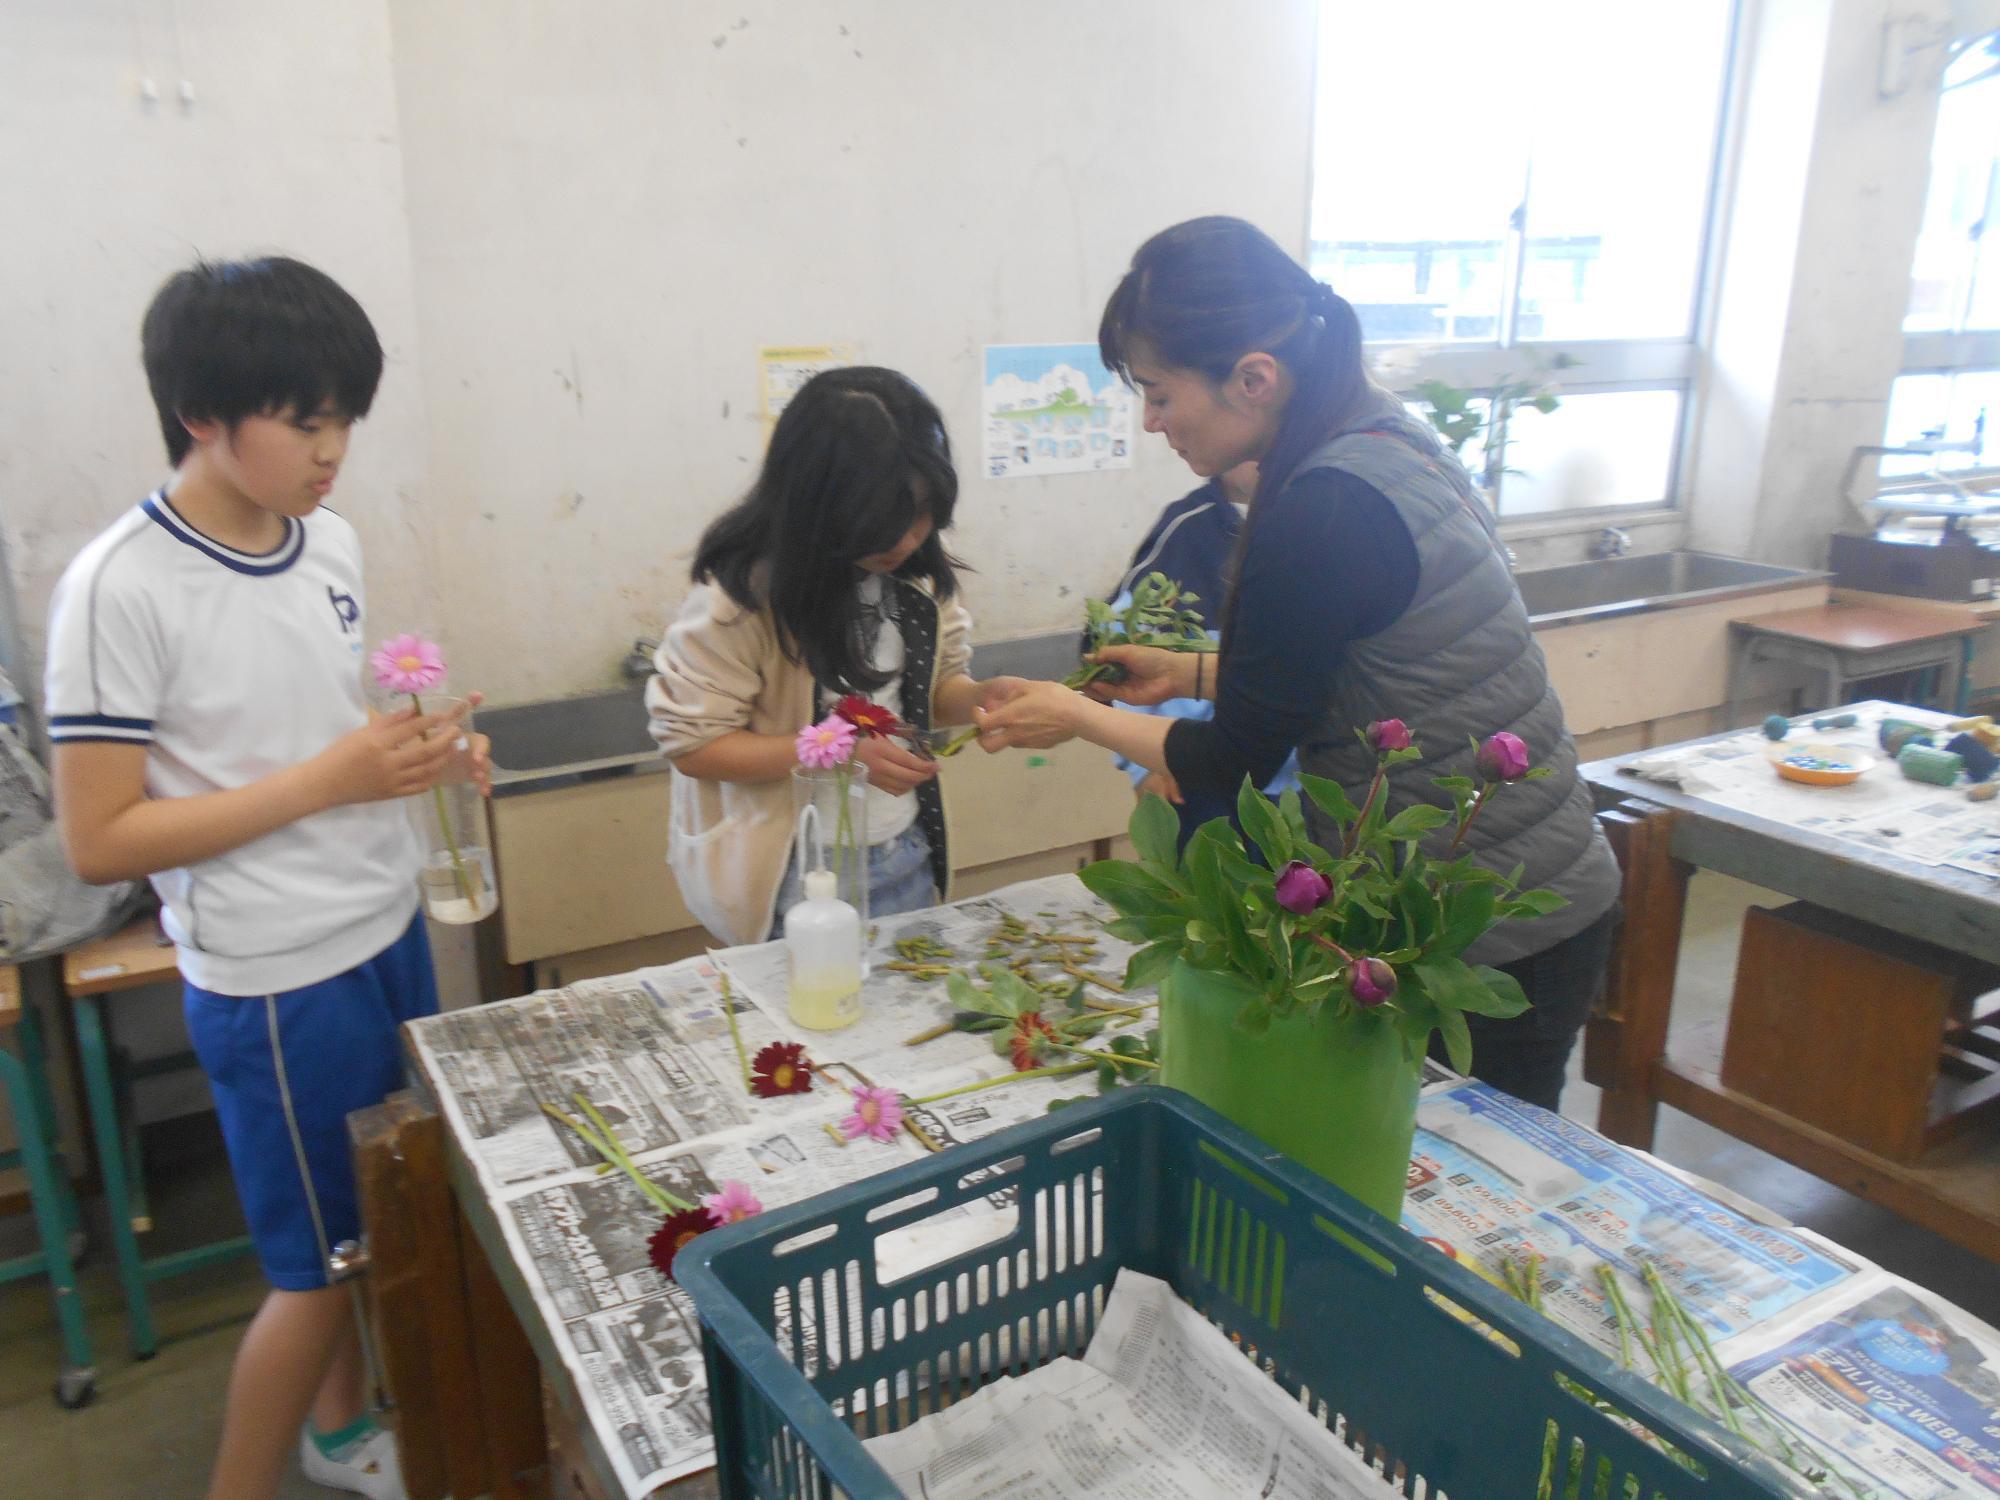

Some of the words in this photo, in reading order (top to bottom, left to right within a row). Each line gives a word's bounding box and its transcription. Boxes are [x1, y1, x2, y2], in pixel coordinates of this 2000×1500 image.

[1811, 1346, 2000, 1471] モデルハウスWEB見学
